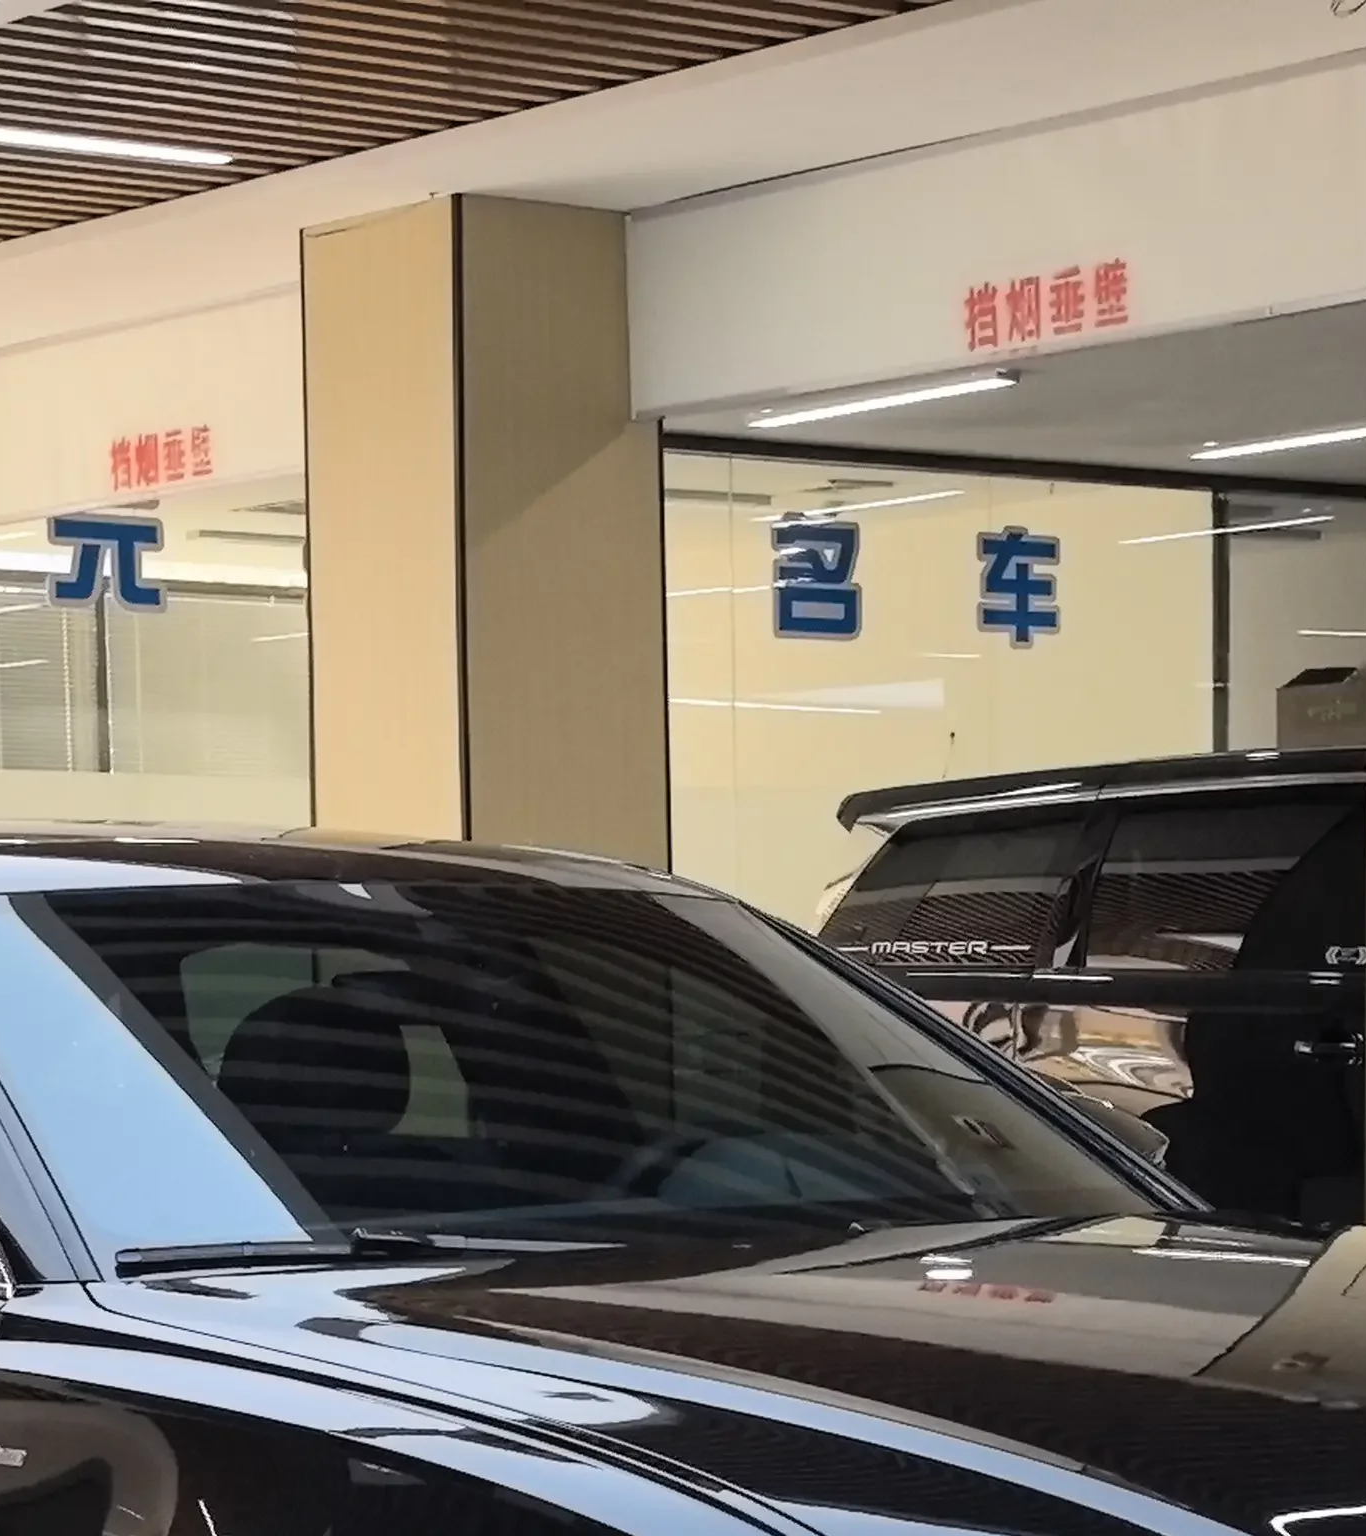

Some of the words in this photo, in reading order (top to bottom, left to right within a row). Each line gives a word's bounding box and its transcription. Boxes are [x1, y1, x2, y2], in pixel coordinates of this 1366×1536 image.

[964, 257, 1129, 352] 挡烟垂壁
[110, 424, 213, 492] 挡烟垂壁
[871, 941, 988, 955] MASTER
